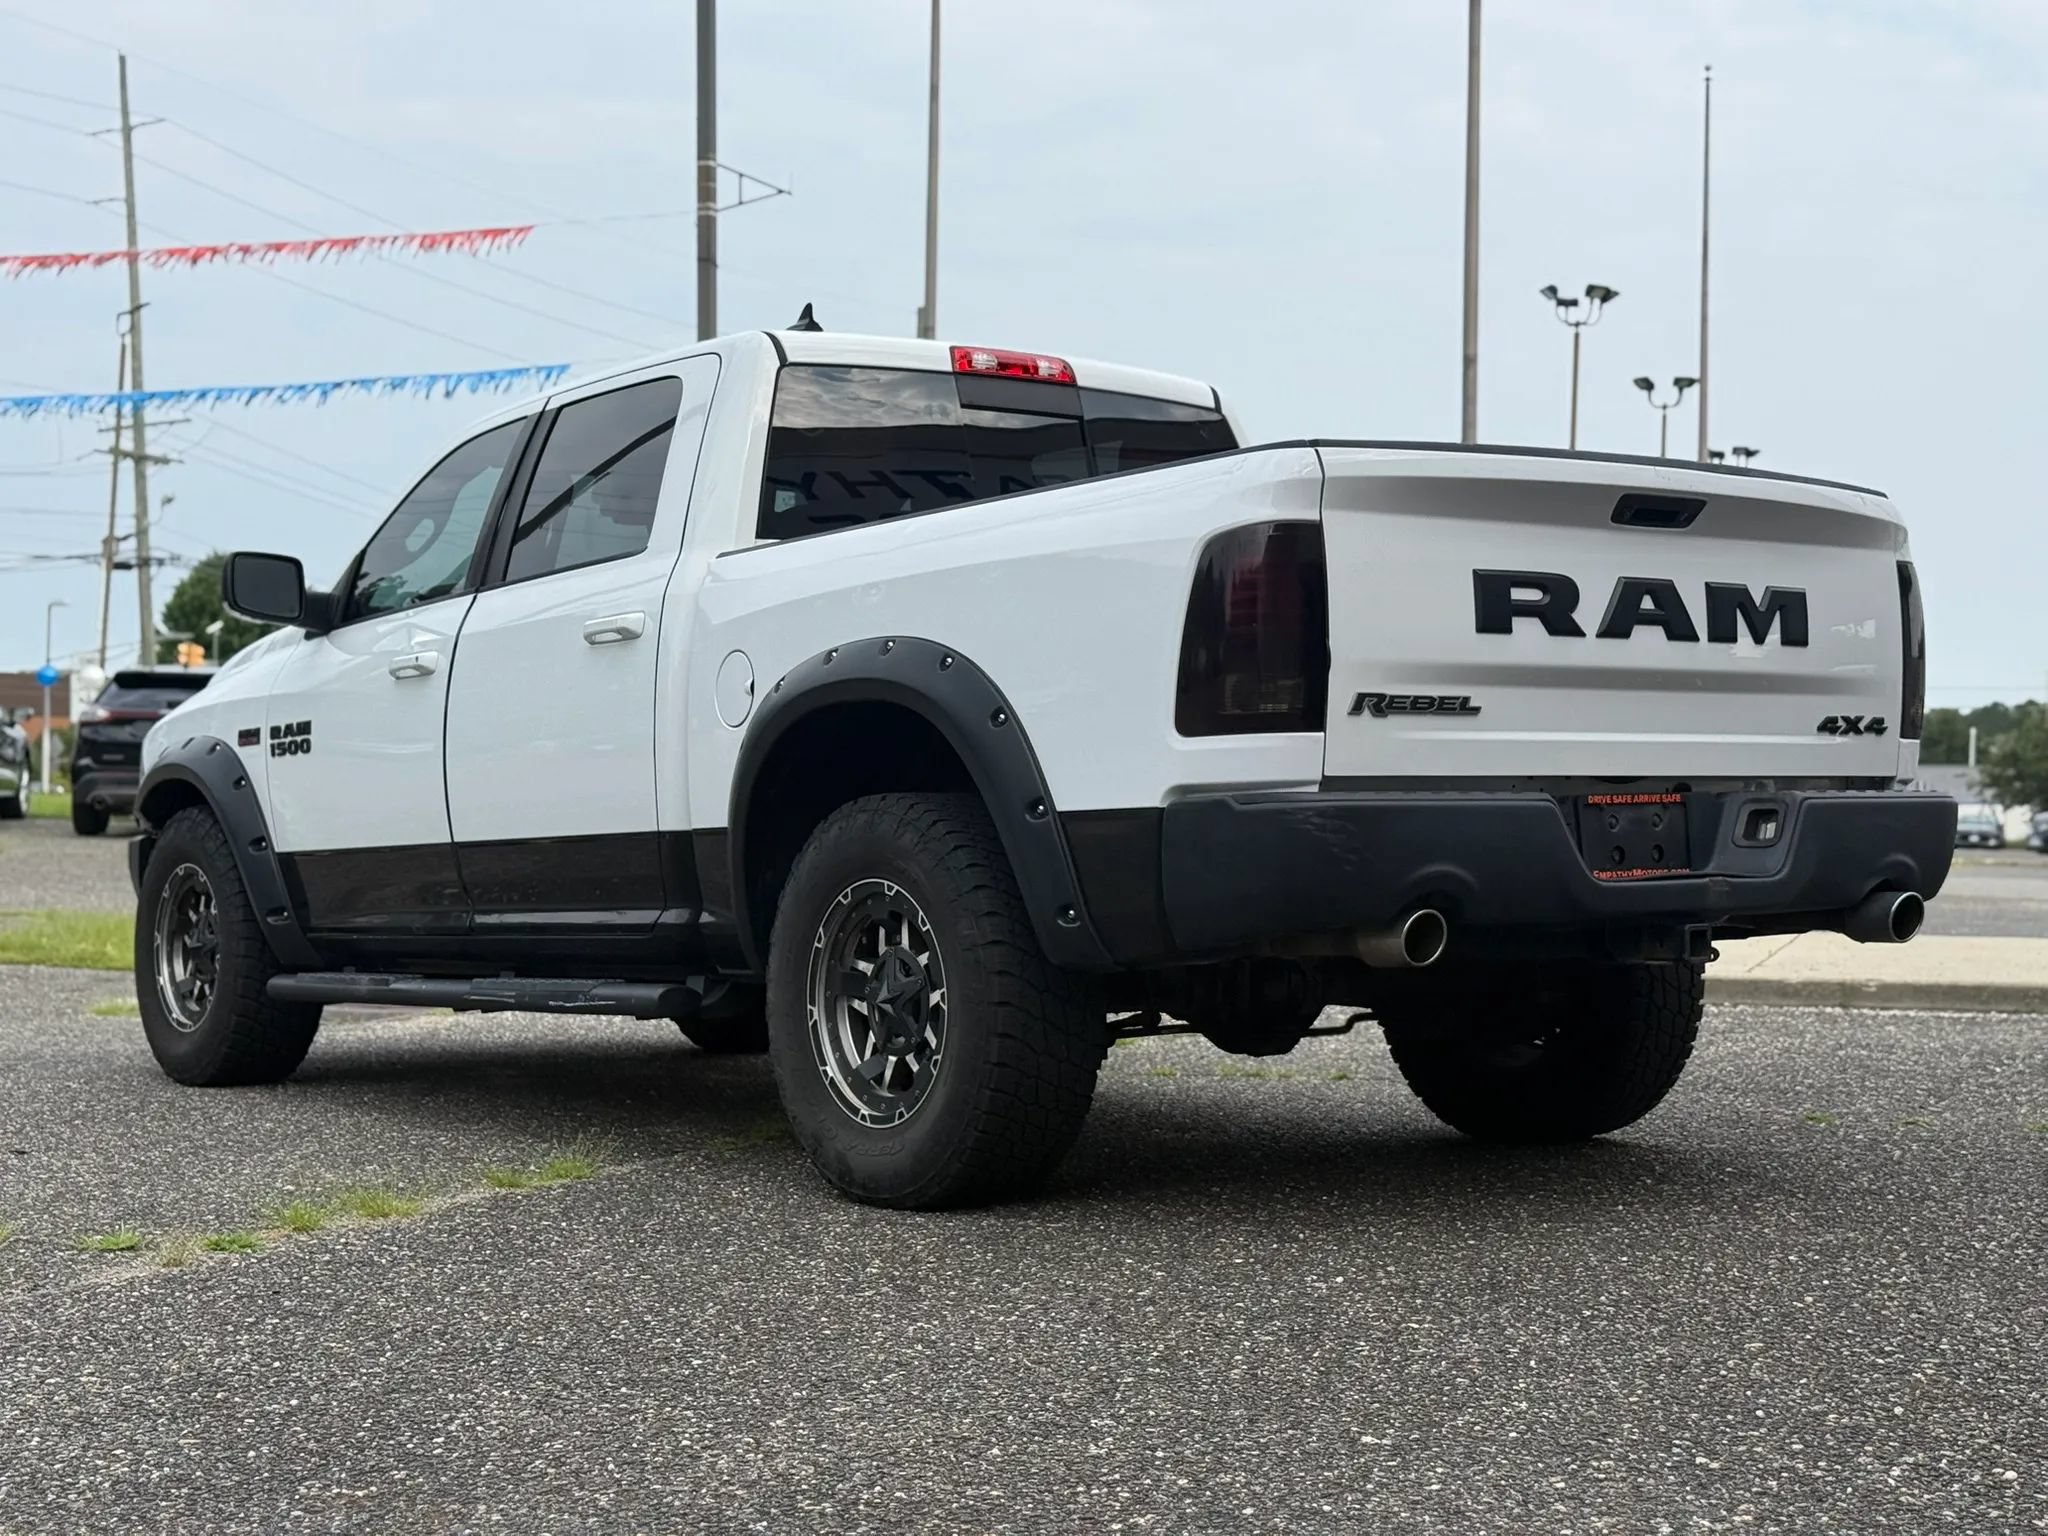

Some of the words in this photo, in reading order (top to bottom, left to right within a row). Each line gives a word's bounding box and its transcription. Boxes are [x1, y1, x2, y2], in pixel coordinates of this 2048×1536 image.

[1472, 568, 1809, 647] RAM
[1347, 691, 1482, 717] REBEL
[269, 720, 312, 741] RAM
[269, 737, 311, 758] 1500
[1588, 795, 1612, 804] DRIVE
[1612, 794, 1633, 804] SAFE
[1633, 793, 1661, 804] ARRIVE
[1661, 793, 1681, 803] SAFE
